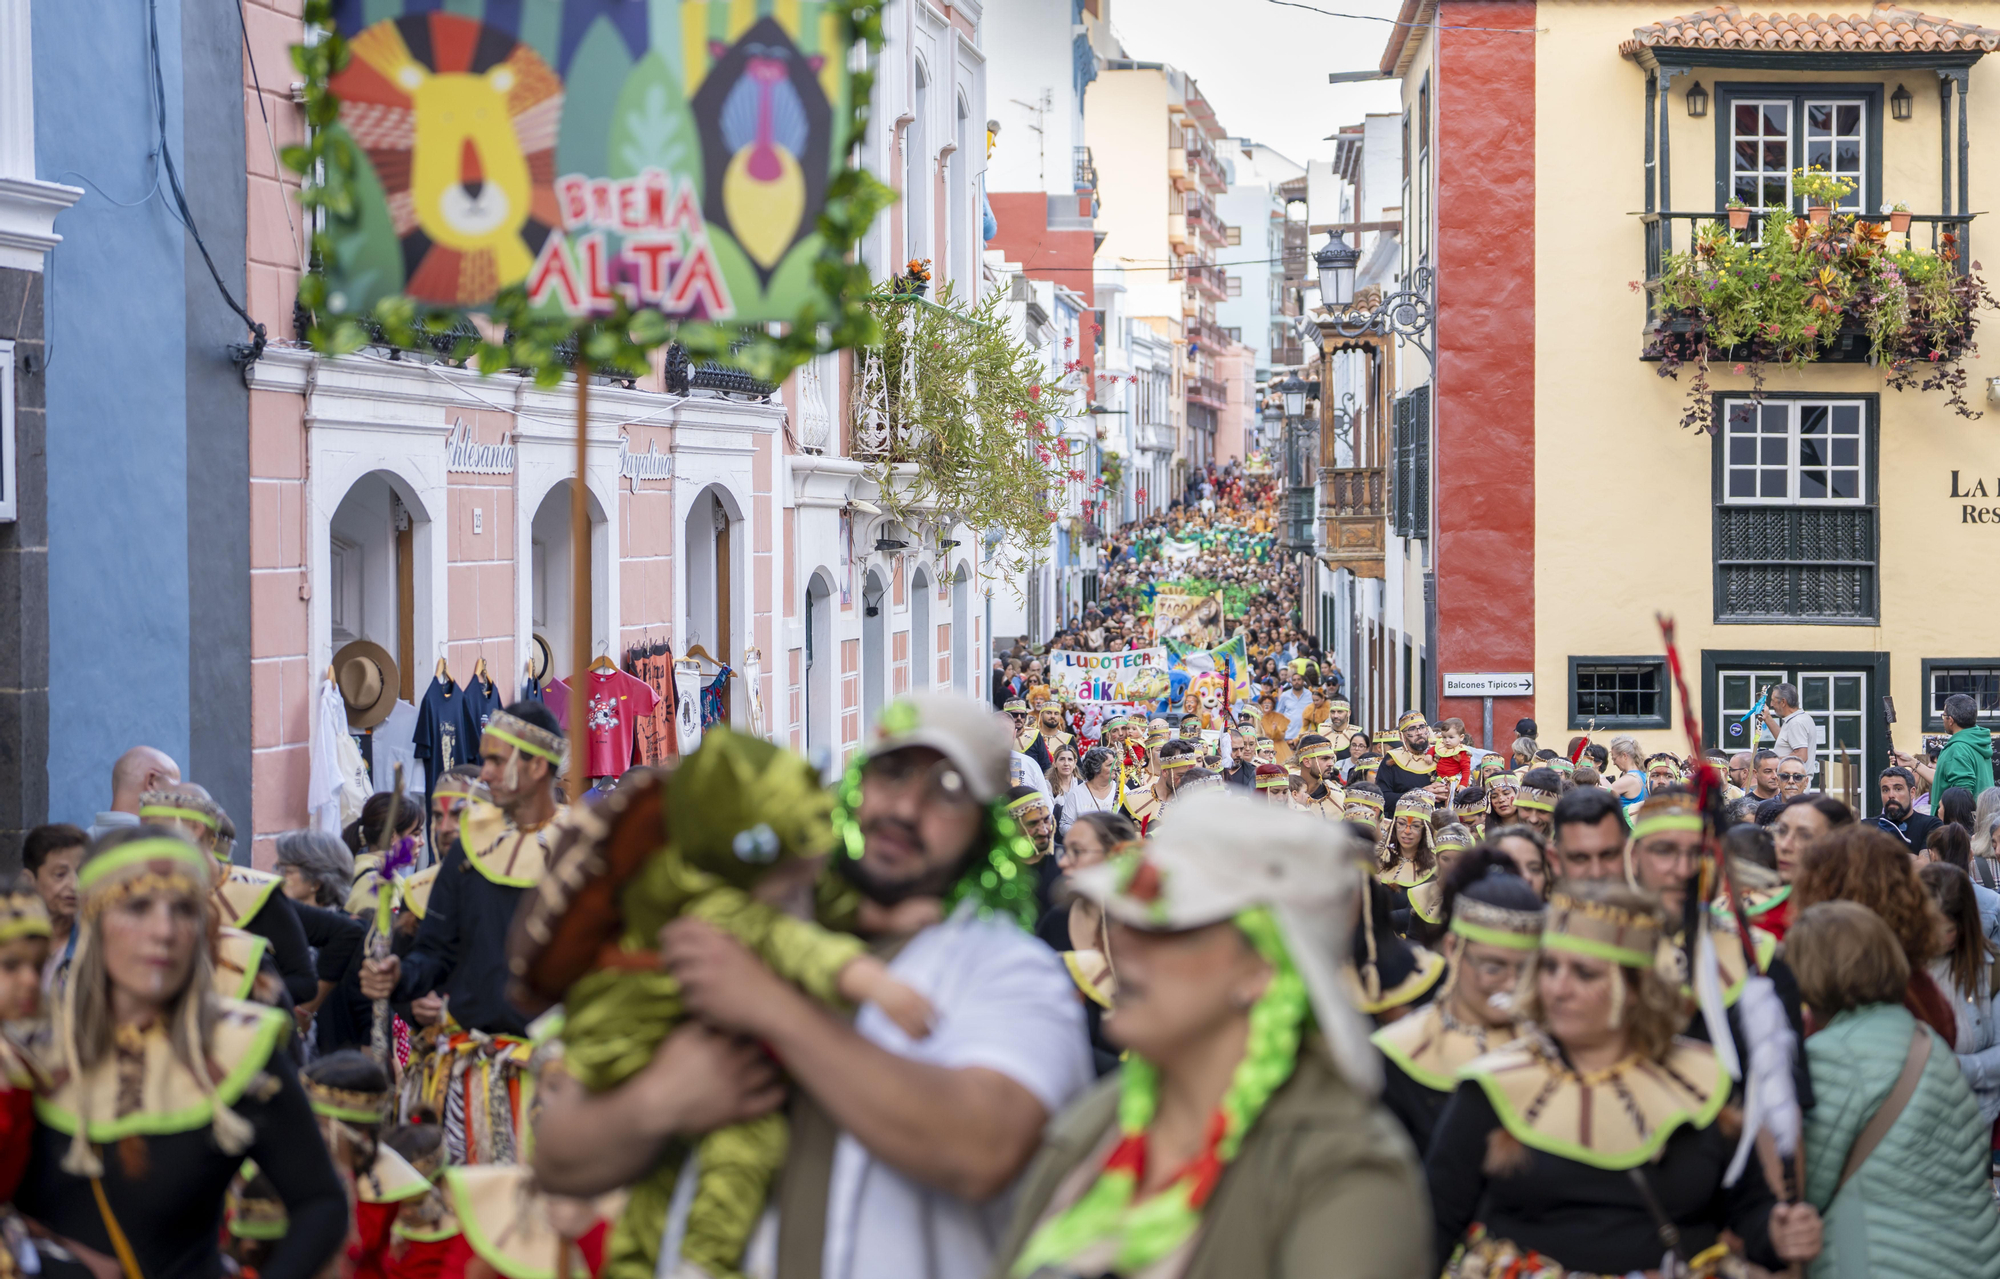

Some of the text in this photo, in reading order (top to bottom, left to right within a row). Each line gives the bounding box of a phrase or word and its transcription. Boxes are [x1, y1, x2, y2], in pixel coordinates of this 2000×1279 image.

[528, 229, 735, 317] ALTA
[1949, 469, 1990, 498] LA
[1066, 652, 1152, 669] LUDOTECA
[1447, 680, 1486, 689] Balcones
